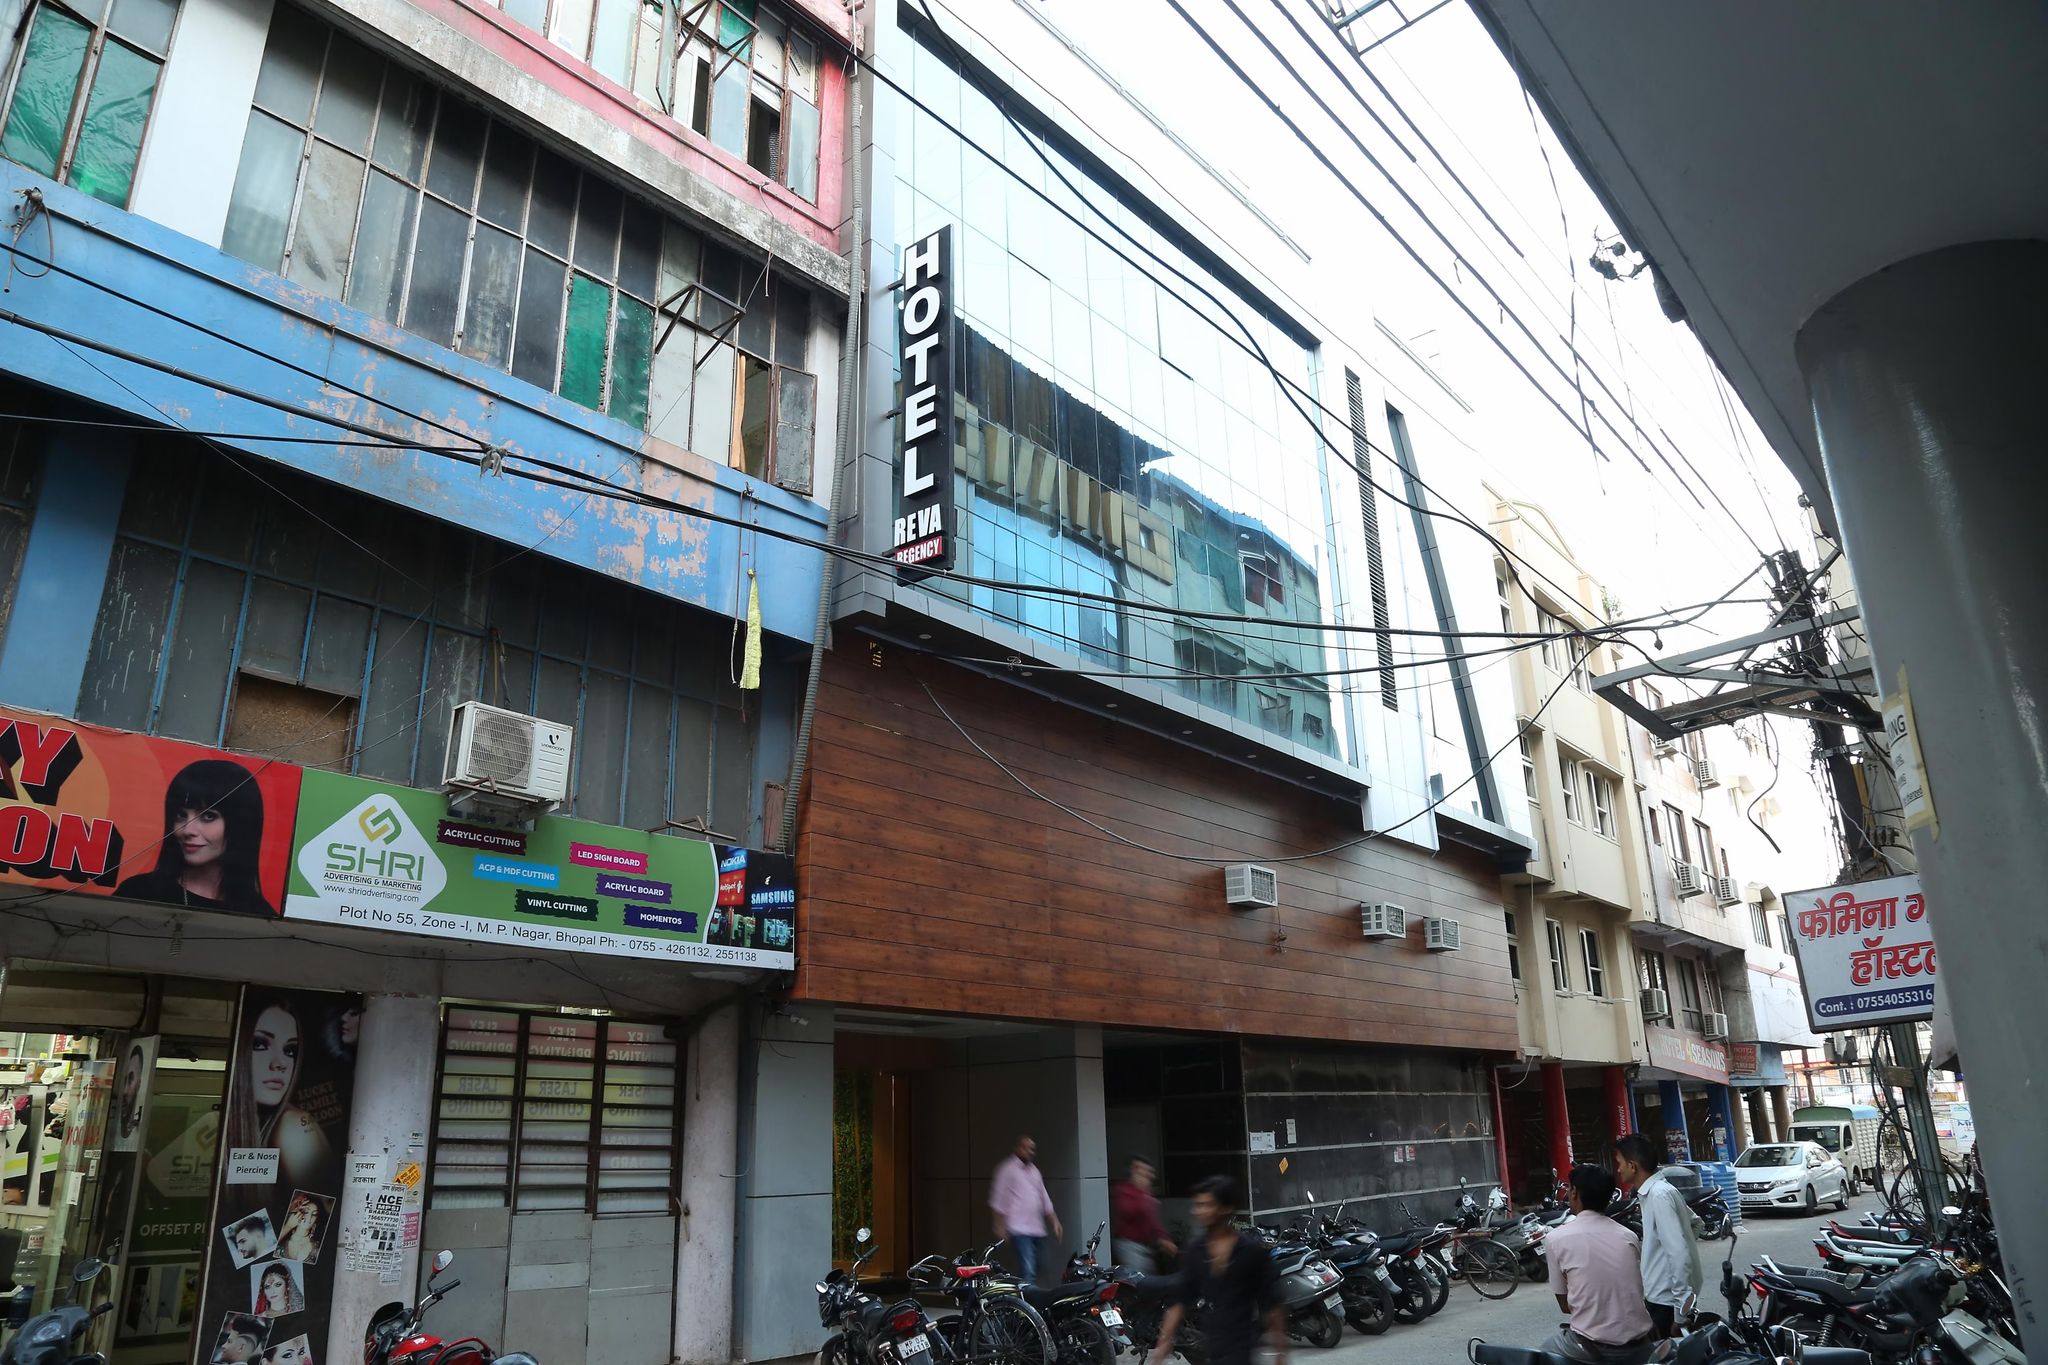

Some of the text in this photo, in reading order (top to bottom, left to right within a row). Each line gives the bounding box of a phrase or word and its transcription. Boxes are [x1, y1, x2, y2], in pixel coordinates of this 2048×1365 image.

[904, 232, 941, 497] HOTEL
[894, 503, 942, 547] REVA
[897, 538, 940, 564] REGENCY
[444, 828, 520, 848] ACRYLIC CUTTING
[326, 843, 424, 881] SHRI
[578, 850, 640, 867] LED SIGN BOARD
[720, 855, 746, 868] NOKIA
[478, 863, 495, 872] ACP
[503, 866, 521, 876] MDF
[522, 869, 555, 881] CUTTING
[323, 872, 422, 891] ADVERTISING & MARKETING
[605, 881, 664, 897] ACRYLIC BOARD
[527, 898, 588, 913] VINYL CUTTING
[751, 889, 795, 905] SAMSUNG
[640, 913, 682, 925] MOMENTOS
[1798, 892, 1899, 939] फेमिना
[339, 905, 367, 920] Plot
[372, 909, 392, 923] No
[397, 912, 417, 927] 55,
[422, 915, 456, 930] Zone
[477, 921, 492, 935] M.
[497, 924, 508, 936] P.
[512, 926, 551, 942] Nagar,
[556, 931, 596, 949] Bhopal
[600, 936, 618, 948] Ph:
[629, 938, 656, 952] 0755
[666, 943, 713, 958] 4261132,
[715, 948, 757, 962] 2551138
[1819, 1003, 1847, 1014] Cont.
[1857, 989, 1933, 1009] 07554055316
[1691, 1044, 1726, 1072] SEASONS
[233, 1152, 278, 1161] Ear & Nose
[236, 1166, 269, 1177] Piercing
[139, 1223, 191, 1237] OFFSET
